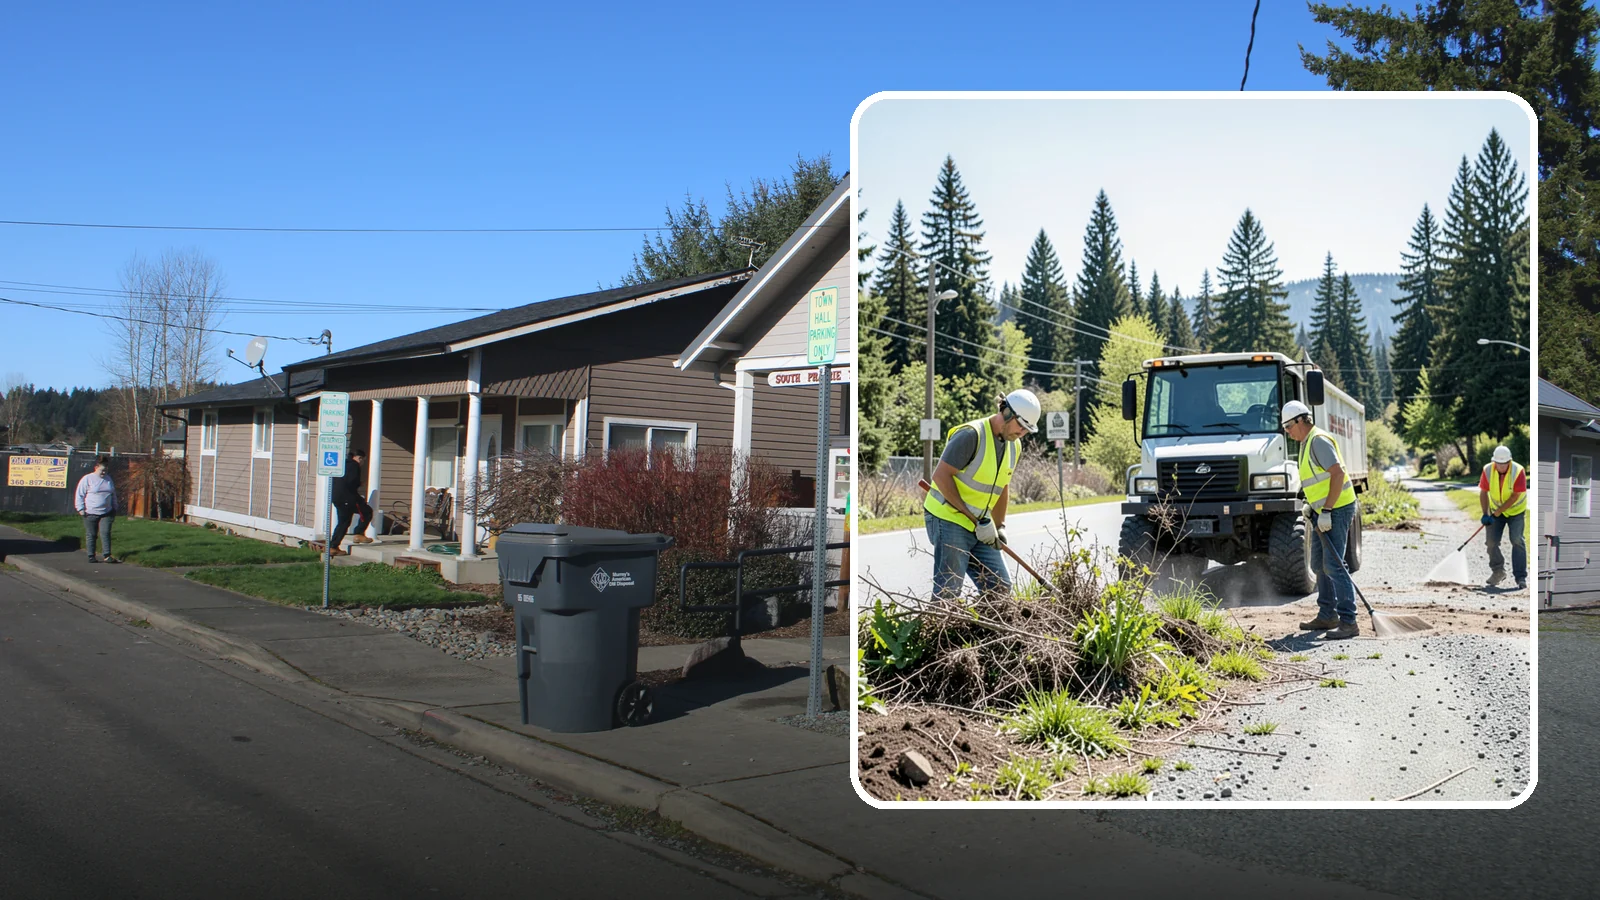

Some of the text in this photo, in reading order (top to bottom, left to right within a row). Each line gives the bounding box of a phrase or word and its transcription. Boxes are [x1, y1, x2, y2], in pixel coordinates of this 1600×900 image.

[815, 294, 833, 308] TOWN
[815, 311, 831, 325] HALL
[810, 326, 836, 341] PARKING
[814, 344, 831, 357] ONLY
[775, 373, 801, 384] SOUTH
[807, 370, 842, 382] PRIE
[325, 420, 340, 428] ONLY
